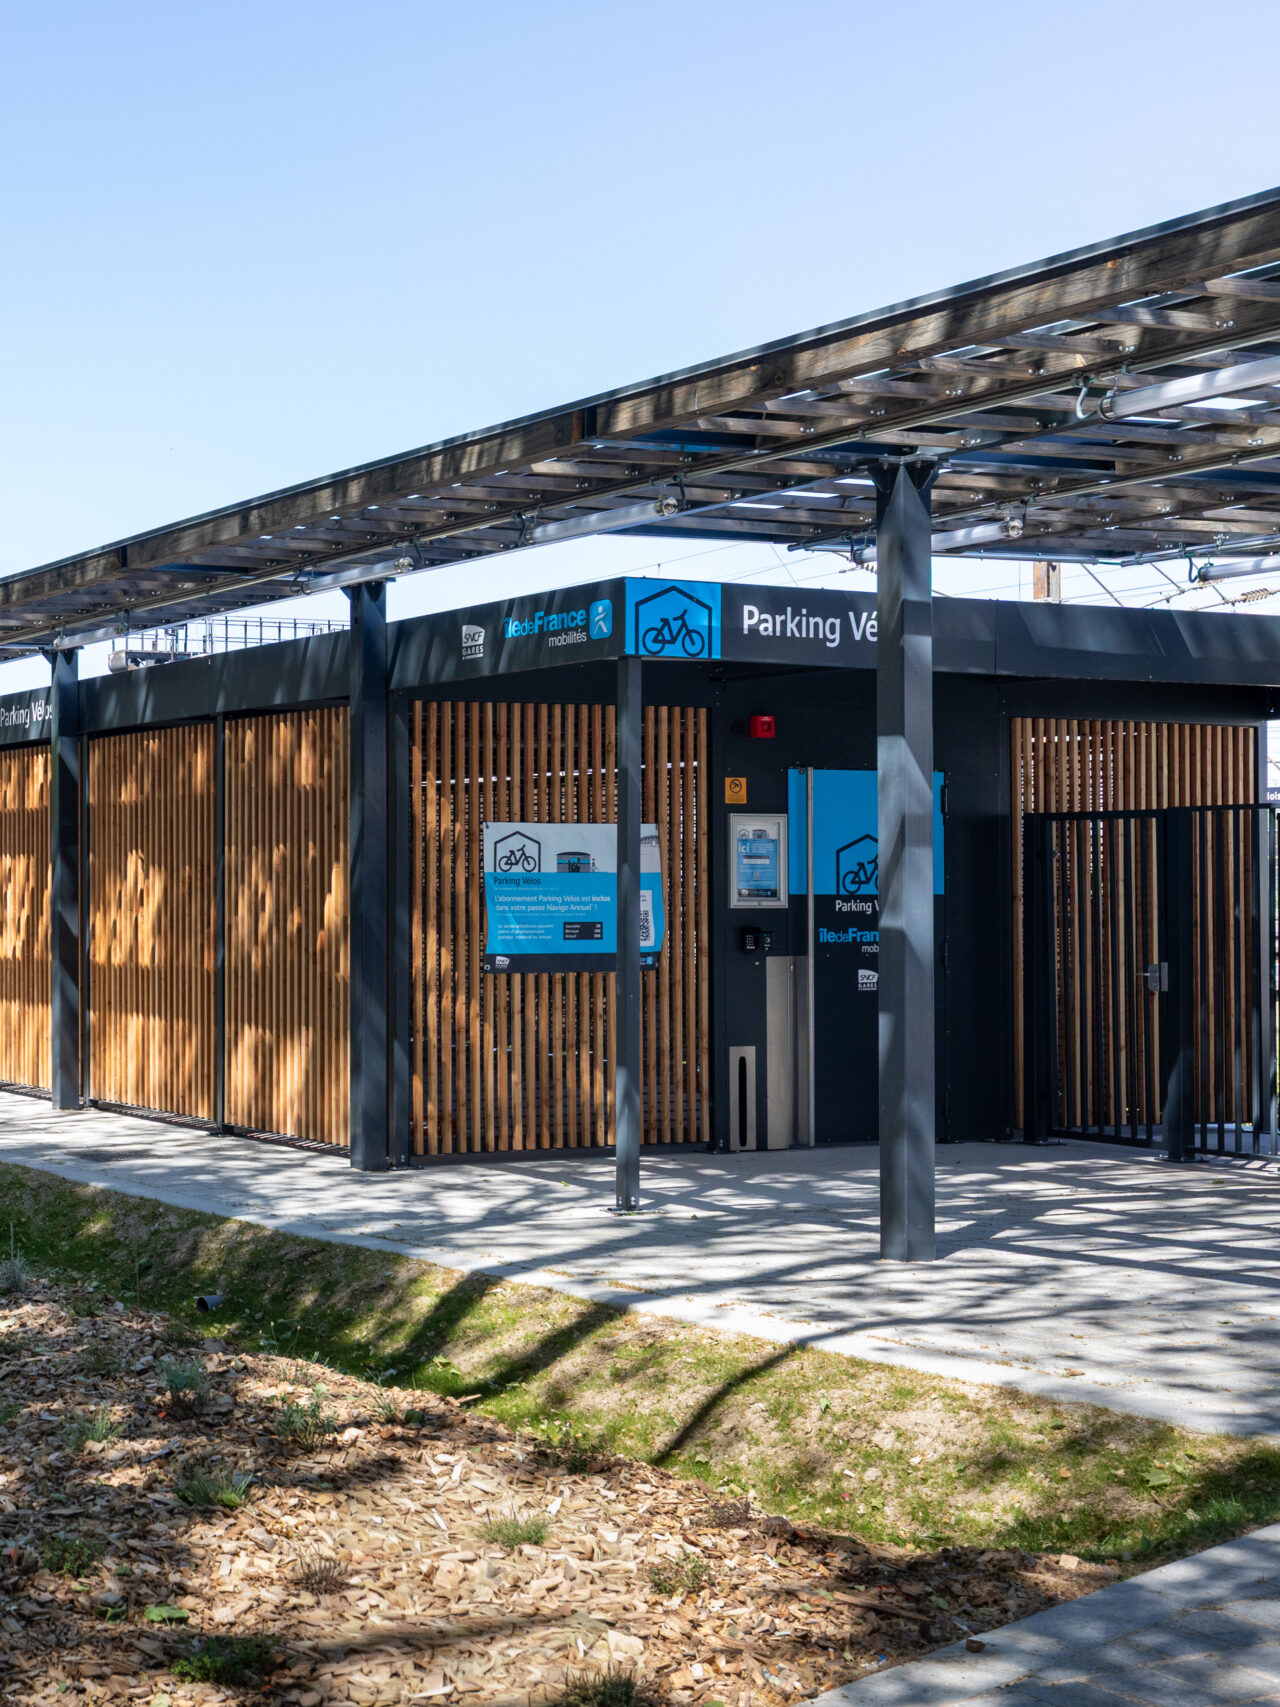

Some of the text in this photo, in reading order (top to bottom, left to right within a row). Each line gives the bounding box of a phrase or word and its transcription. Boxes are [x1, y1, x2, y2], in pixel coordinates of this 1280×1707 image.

[743, 605, 841, 648] Parking
[464, 631, 483, 644] SNCF
[548, 628, 587, 648] mobilités
[462, 645, 484, 656] GARES
[0, 705, 30, 729] Parking
[738, 842, 750, 853] ici
[493, 876, 542, 887] Parking Vélos
[538, 895, 562, 904] Parking
[527, 905, 545, 913] passe
[546, 904, 569, 913] Navigo
[835, 899, 873, 915] Parking
[859, 974, 877, 982] SNCF
